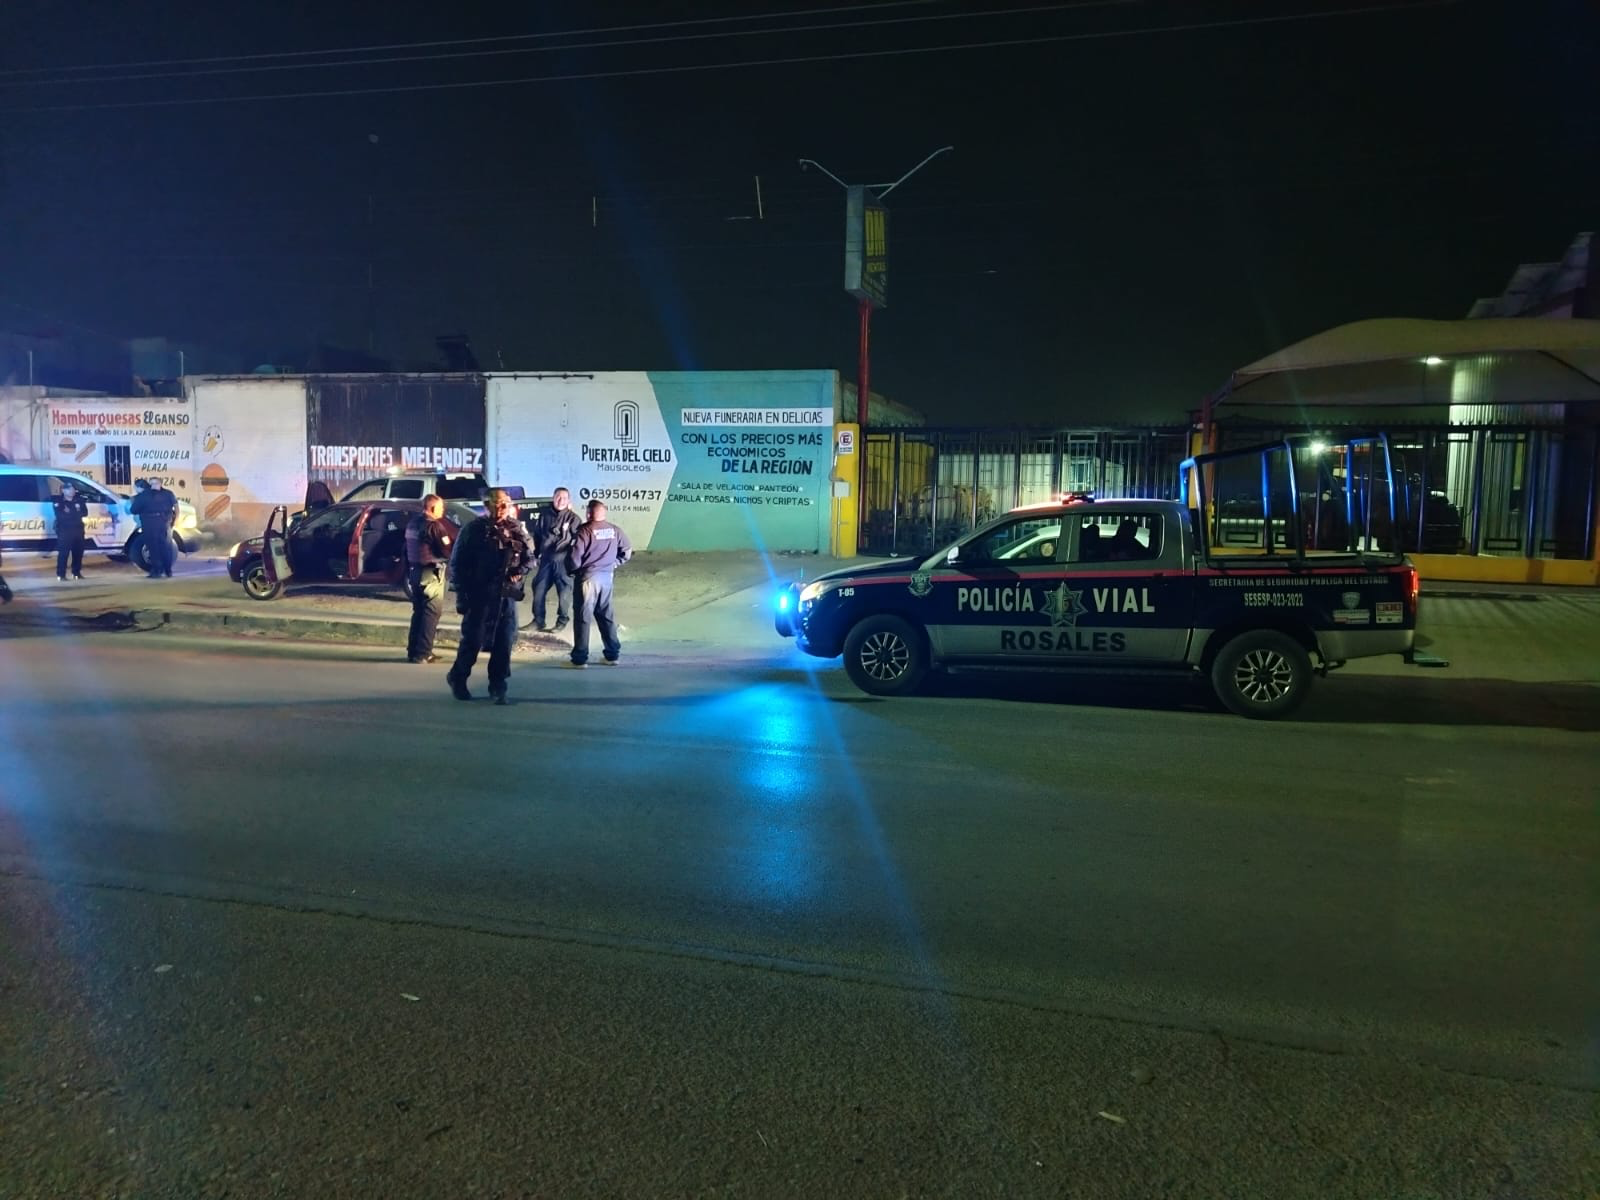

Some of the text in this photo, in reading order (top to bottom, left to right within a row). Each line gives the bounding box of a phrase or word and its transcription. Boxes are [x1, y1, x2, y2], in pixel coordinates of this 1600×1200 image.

[52, 409, 141, 431] Hamburguesas
[154, 414, 190, 425] GANSO
[683, 411, 823, 424] NUEVA FUNERARIA EN DELICIAS
[681, 432, 823, 445] CON LOS PRECIOS MÁS
[134, 450, 190, 460] CIRCULO DE LA
[311, 445, 483, 469] TRANSPORTES MELENDEZ
[582, 444, 671, 462] PUERTA DEL CIELO
[141, 463, 168, 472] PLAZA
[721, 457, 813, 475] DE LA REGIÓN
[681, 482, 701, 490] SALA
[591, 488, 662, 500] 6395014737
[667, 494, 701, 503] CAPILLA
[704, 495, 731, 503] FOSAS
[733, 496, 763, 505] NICHOS
[772, 497, 810, 506] CRIPTAS
[1344, 576, 1359, 585] DEL
[957, 582, 1155, 613] POLICÍA VIAL
[1244, 592, 1304, 607] SESESP-023-2022
[1001, 630, 1126, 652] ROSALES
